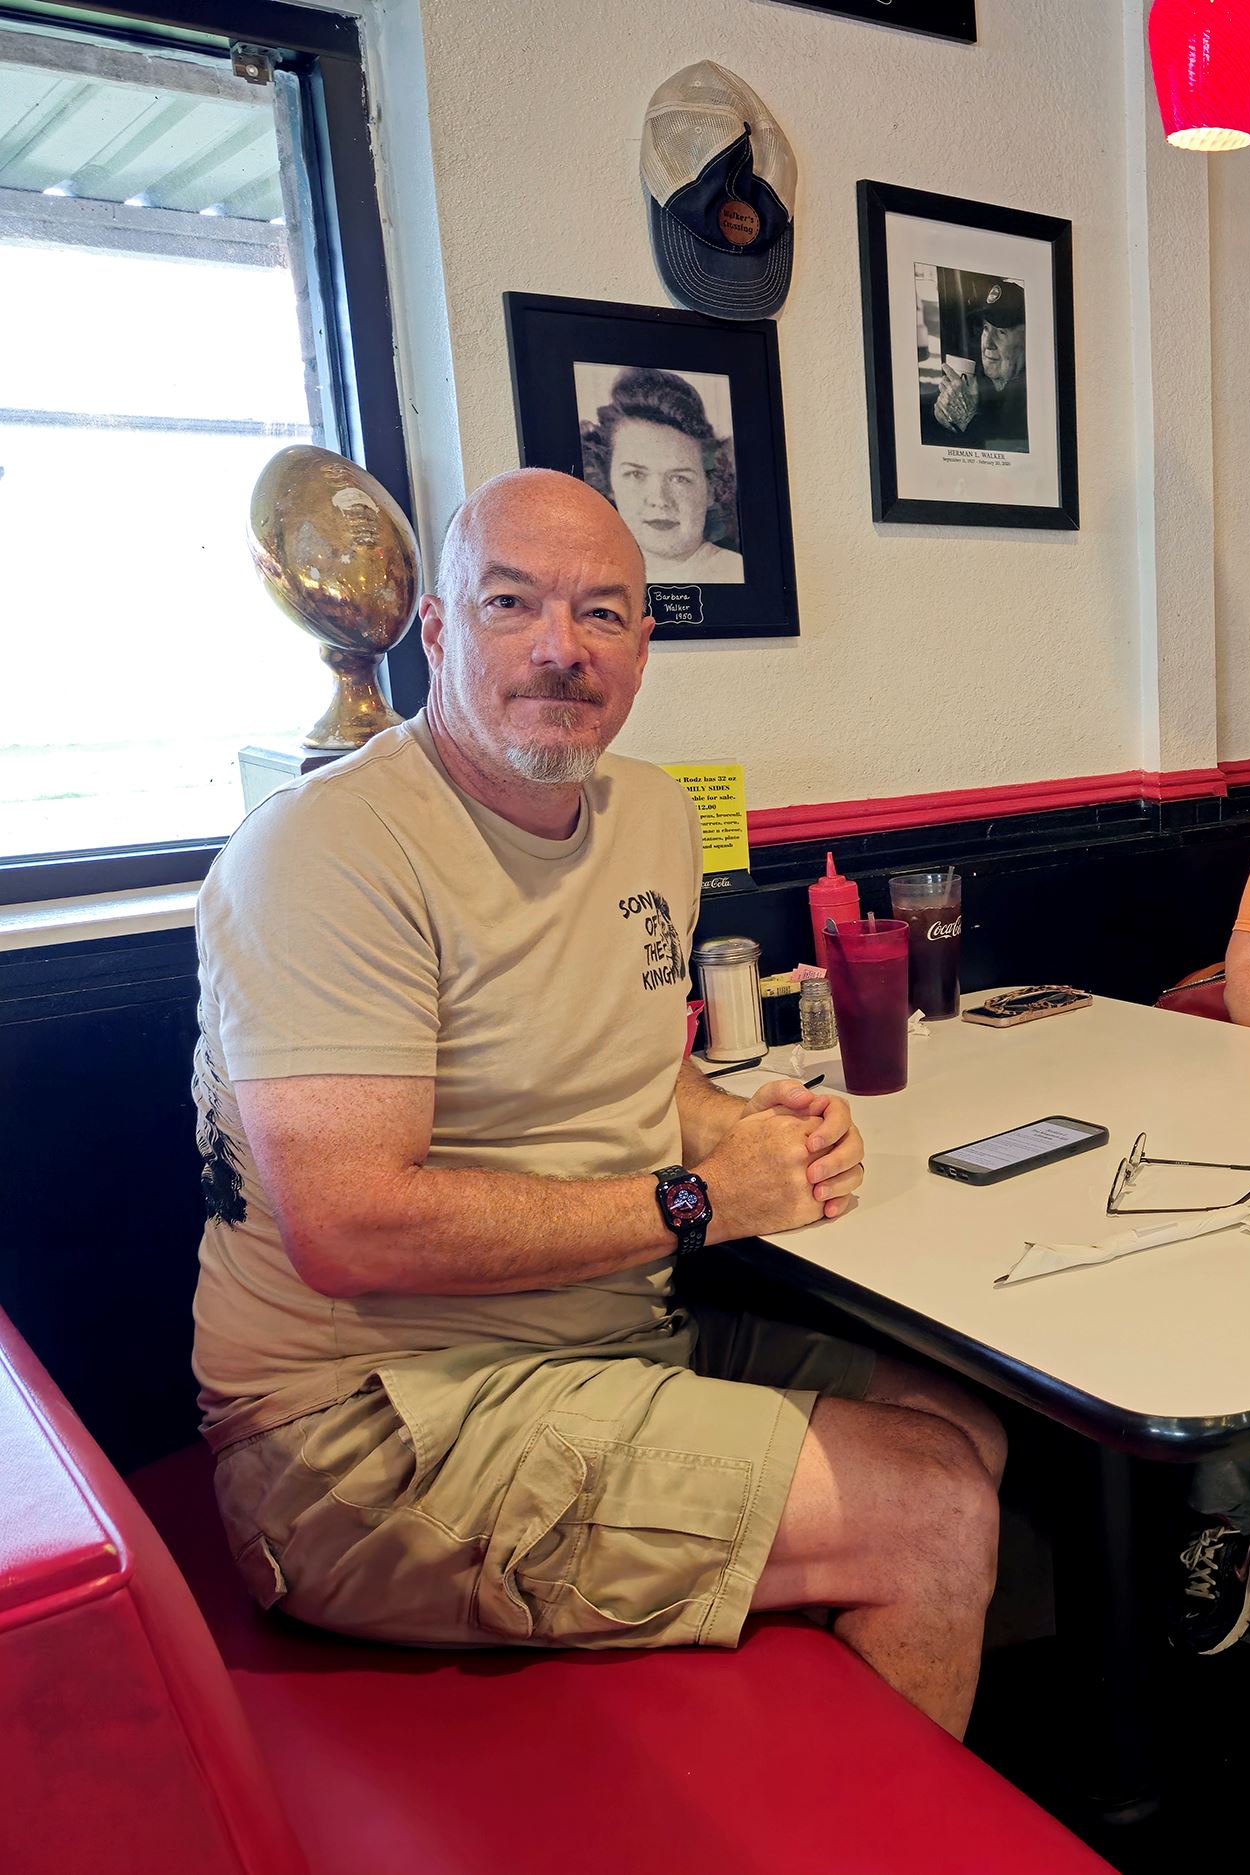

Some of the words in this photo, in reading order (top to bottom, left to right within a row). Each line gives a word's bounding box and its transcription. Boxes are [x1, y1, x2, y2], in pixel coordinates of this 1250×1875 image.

[947, 449, 973, 457] HERMAN
[981, 452, 1006, 460] WALKER
[653, 591, 691, 601] Barbara
[664, 603, 690, 612] Walker
[675, 612, 692, 620] 1950
[618, 890, 654, 919] SON
[644, 914, 658, 936] OF
[643, 940, 665, 966] THE
